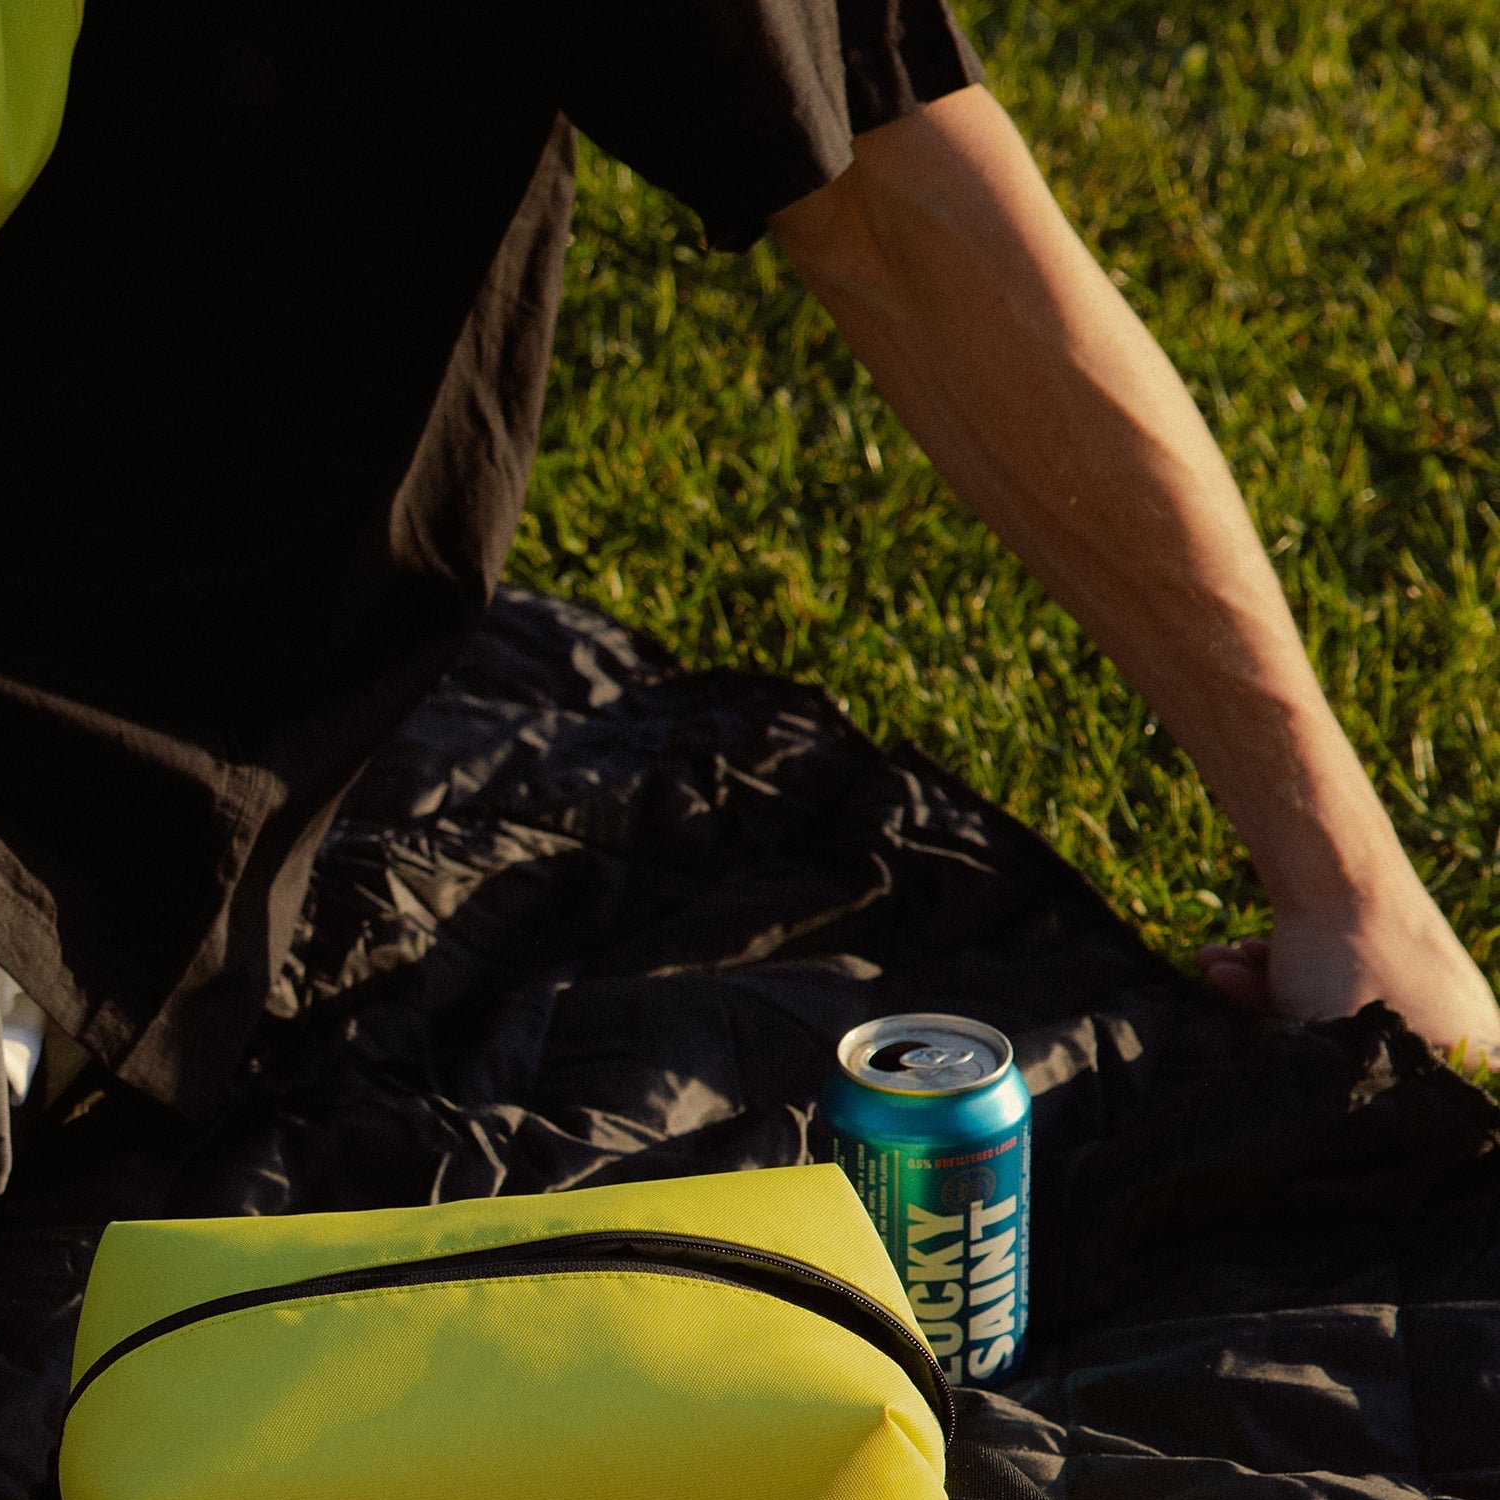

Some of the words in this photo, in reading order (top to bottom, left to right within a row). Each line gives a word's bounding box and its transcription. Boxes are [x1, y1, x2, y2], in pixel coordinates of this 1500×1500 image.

[934, 1149, 994, 1168] UNFILTERED
[995, 1135, 1017, 1156] LAGER
[968, 1194, 1017, 1381] SAINT
